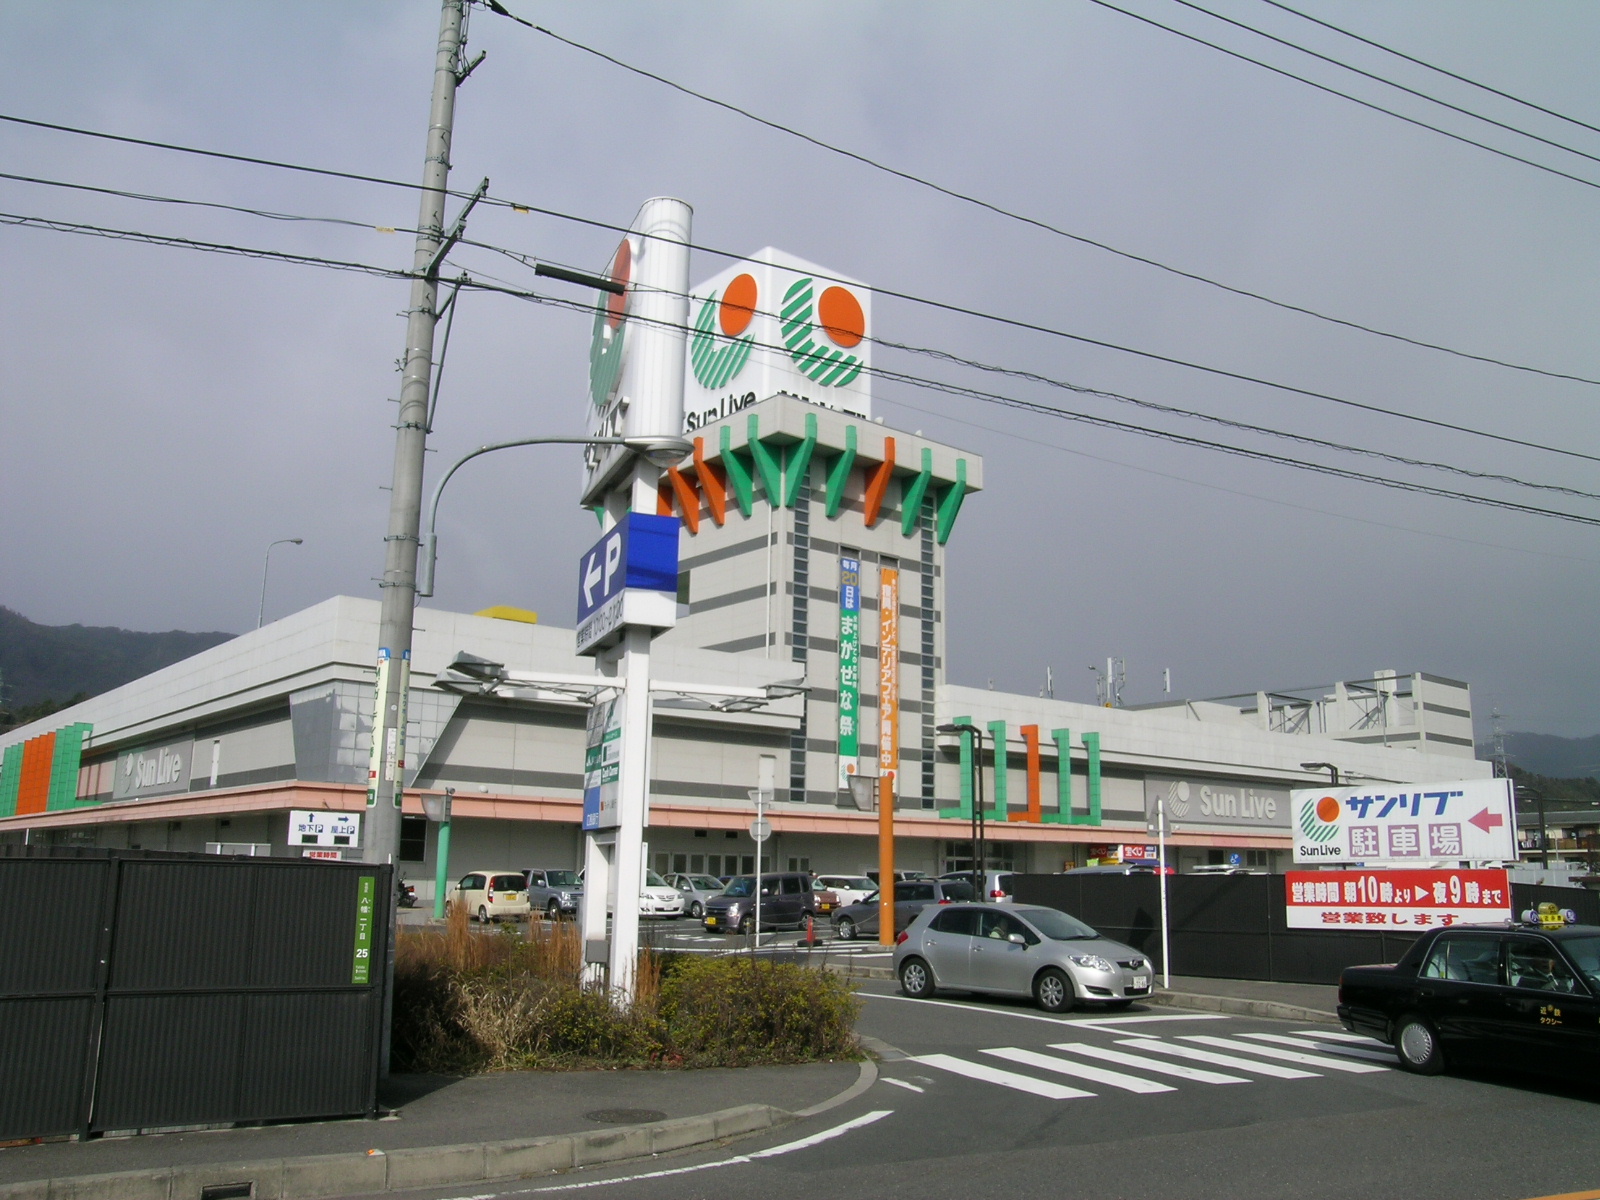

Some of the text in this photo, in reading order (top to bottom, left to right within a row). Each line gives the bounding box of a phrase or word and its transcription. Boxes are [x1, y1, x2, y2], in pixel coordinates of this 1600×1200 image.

[603, 532, 622, 597] P
[842, 571, 858, 586] 20
[840, 616, 853, 736] まかせな祭
[135, 747, 181, 789] Sun Live
[1199, 785, 1277, 819] Sun Live
[1345, 790, 1464, 819] サンリブ
[1351, 825, 1460, 856] 駐車場
[1291, 881, 1339, 903] 営業時間
[1321, 911, 1459, 926] 営業致します
[356, 949, 368, 958] 25
[1540, 1017, 1563, 1025] タクシー
